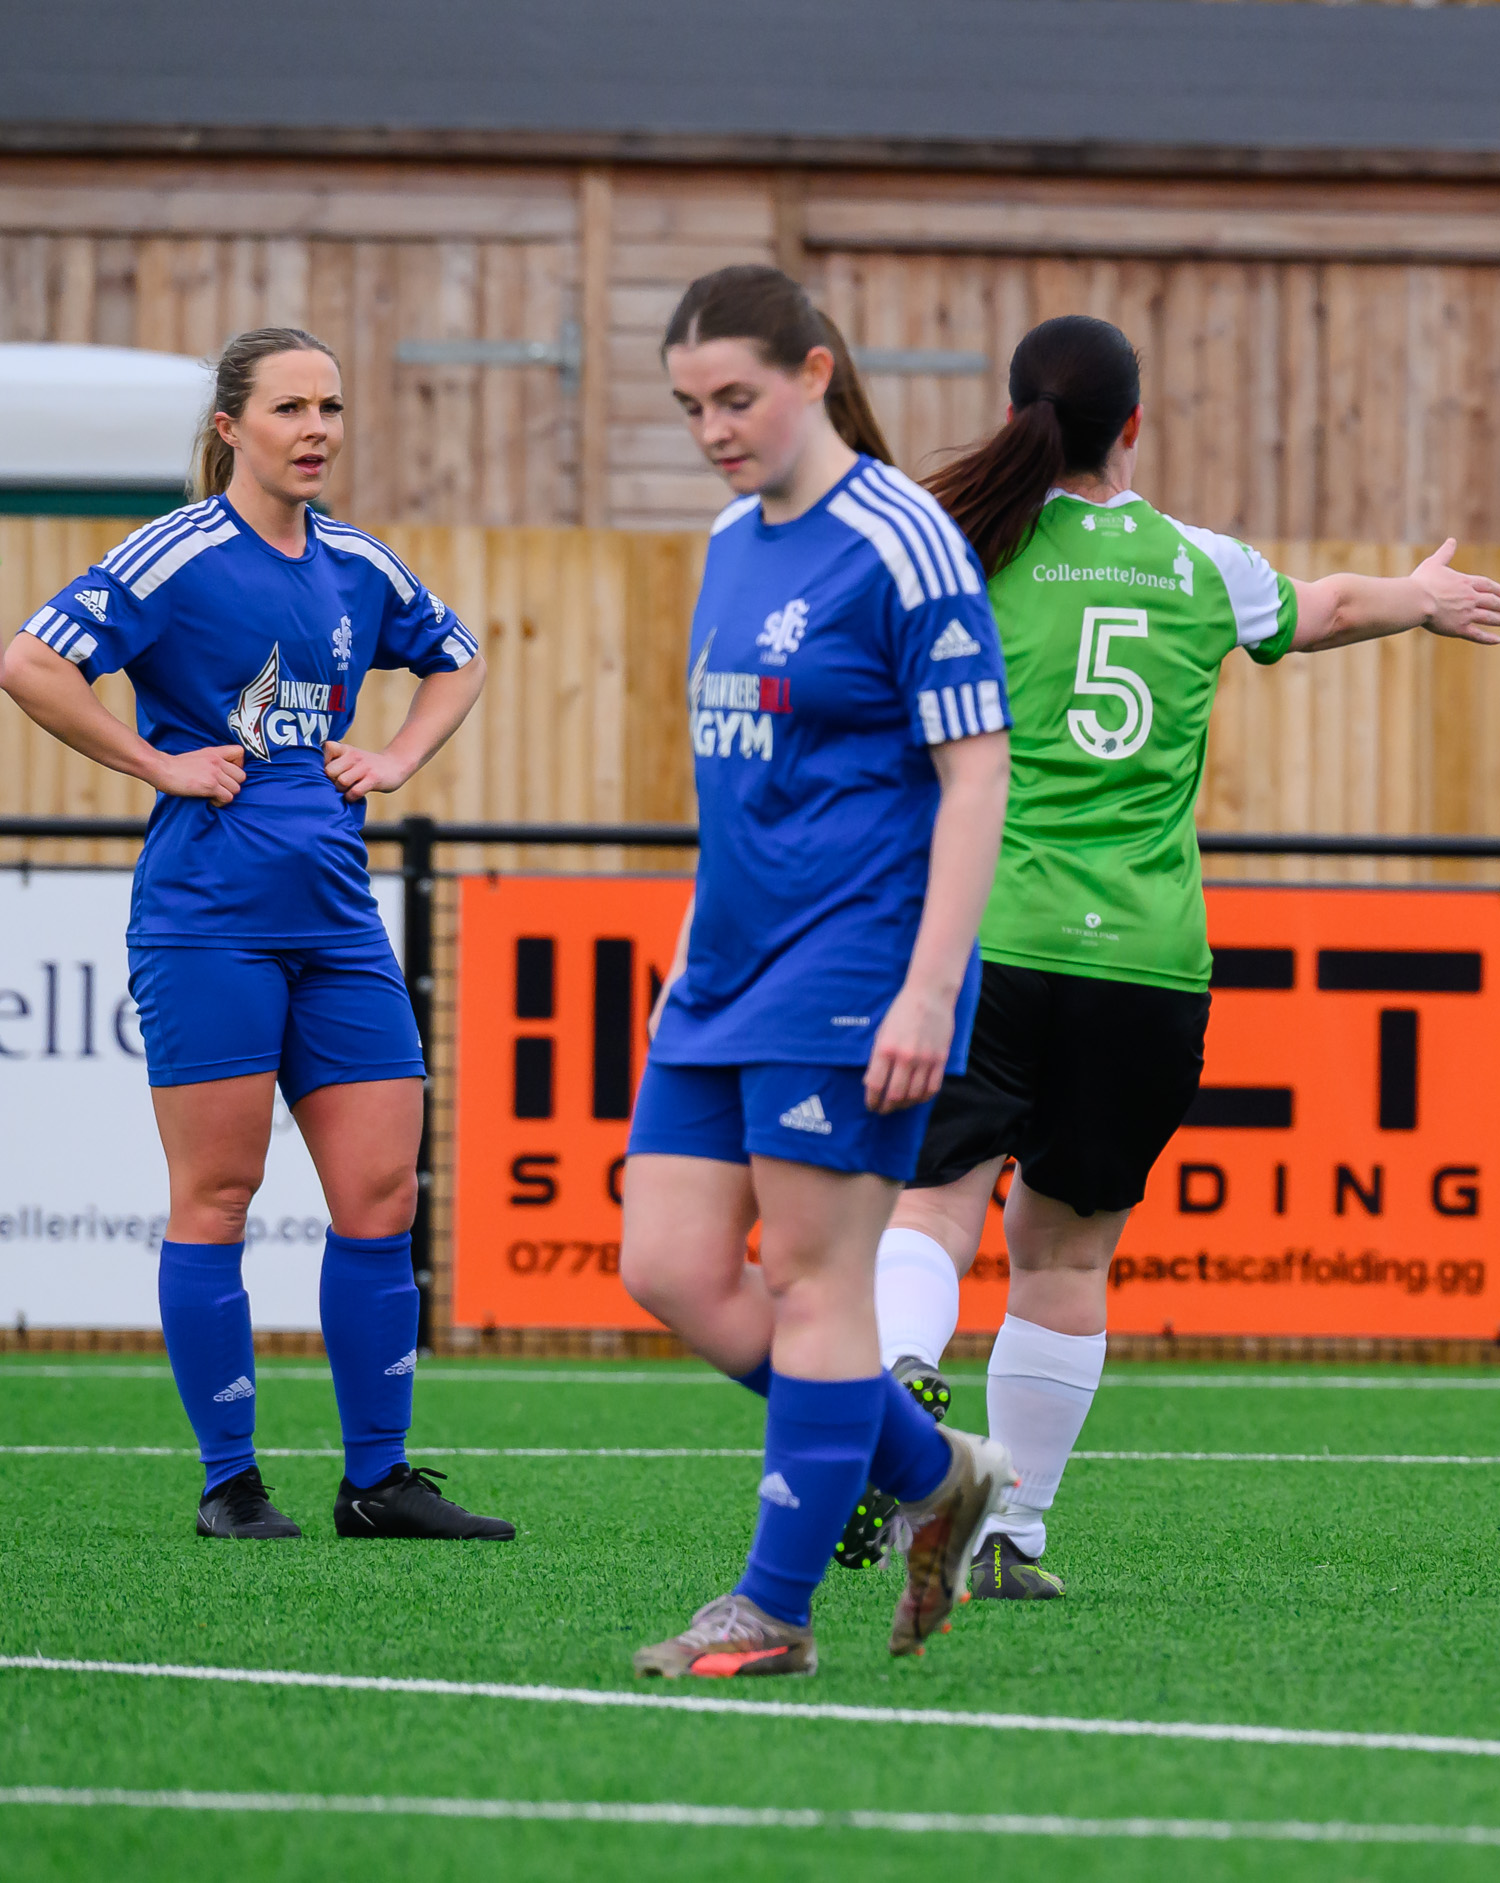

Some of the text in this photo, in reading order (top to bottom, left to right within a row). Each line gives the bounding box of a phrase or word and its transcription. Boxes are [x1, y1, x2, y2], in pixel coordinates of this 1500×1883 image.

[73, 592, 108, 623] adidas
[1067, 606, 1154, 761] 5
[692, 709, 774, 762] GYM
